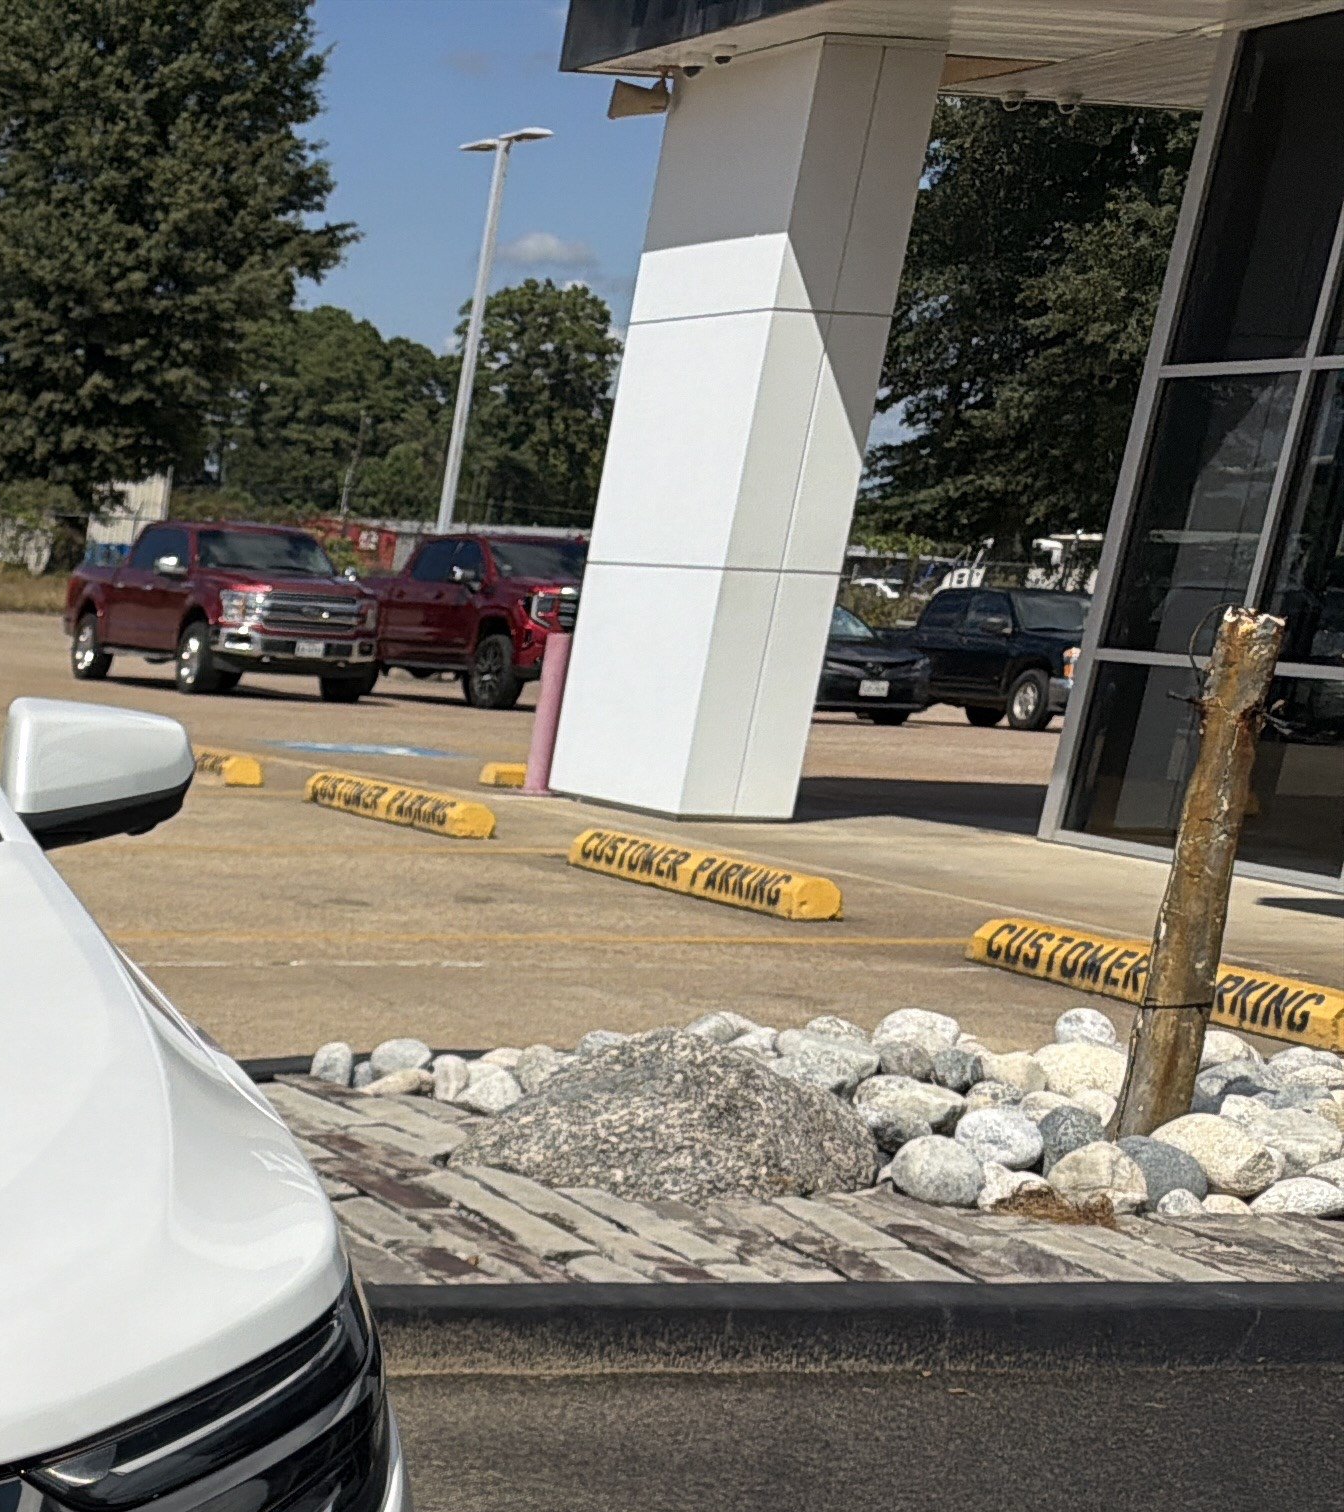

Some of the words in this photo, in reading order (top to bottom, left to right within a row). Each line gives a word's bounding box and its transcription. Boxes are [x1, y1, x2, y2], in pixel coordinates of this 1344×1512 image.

[313, 774, 389, 809] CUSTOMER
[386, 790, 457, 826] PARKING
[581, 832, 692, 881] CUSTOMER
[690, 857, 792, 906] PARKING
[986, 924, 1150, 992] CUSTOMER
[1216, 974, 1326, 1032] RKING
